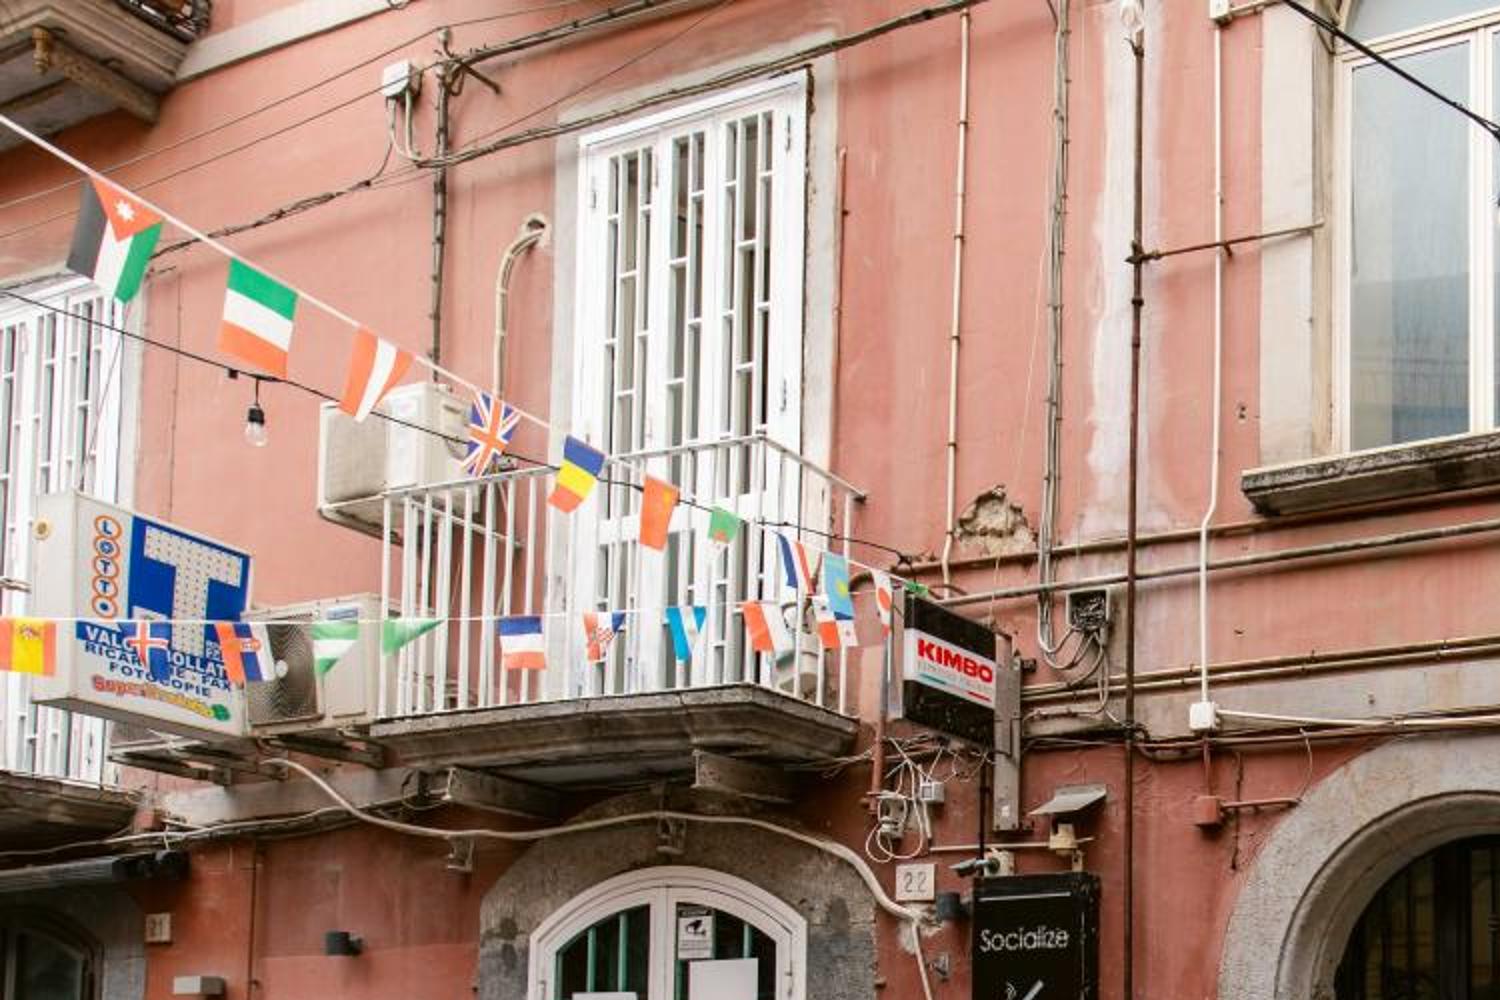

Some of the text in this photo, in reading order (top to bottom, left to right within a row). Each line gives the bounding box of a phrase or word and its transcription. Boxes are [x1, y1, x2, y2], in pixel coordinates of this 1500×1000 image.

[917, 638, 993, 683] KIMBO
[904, 871, 927, 893] 22
[980, 926, 1070, 952] Socialize
